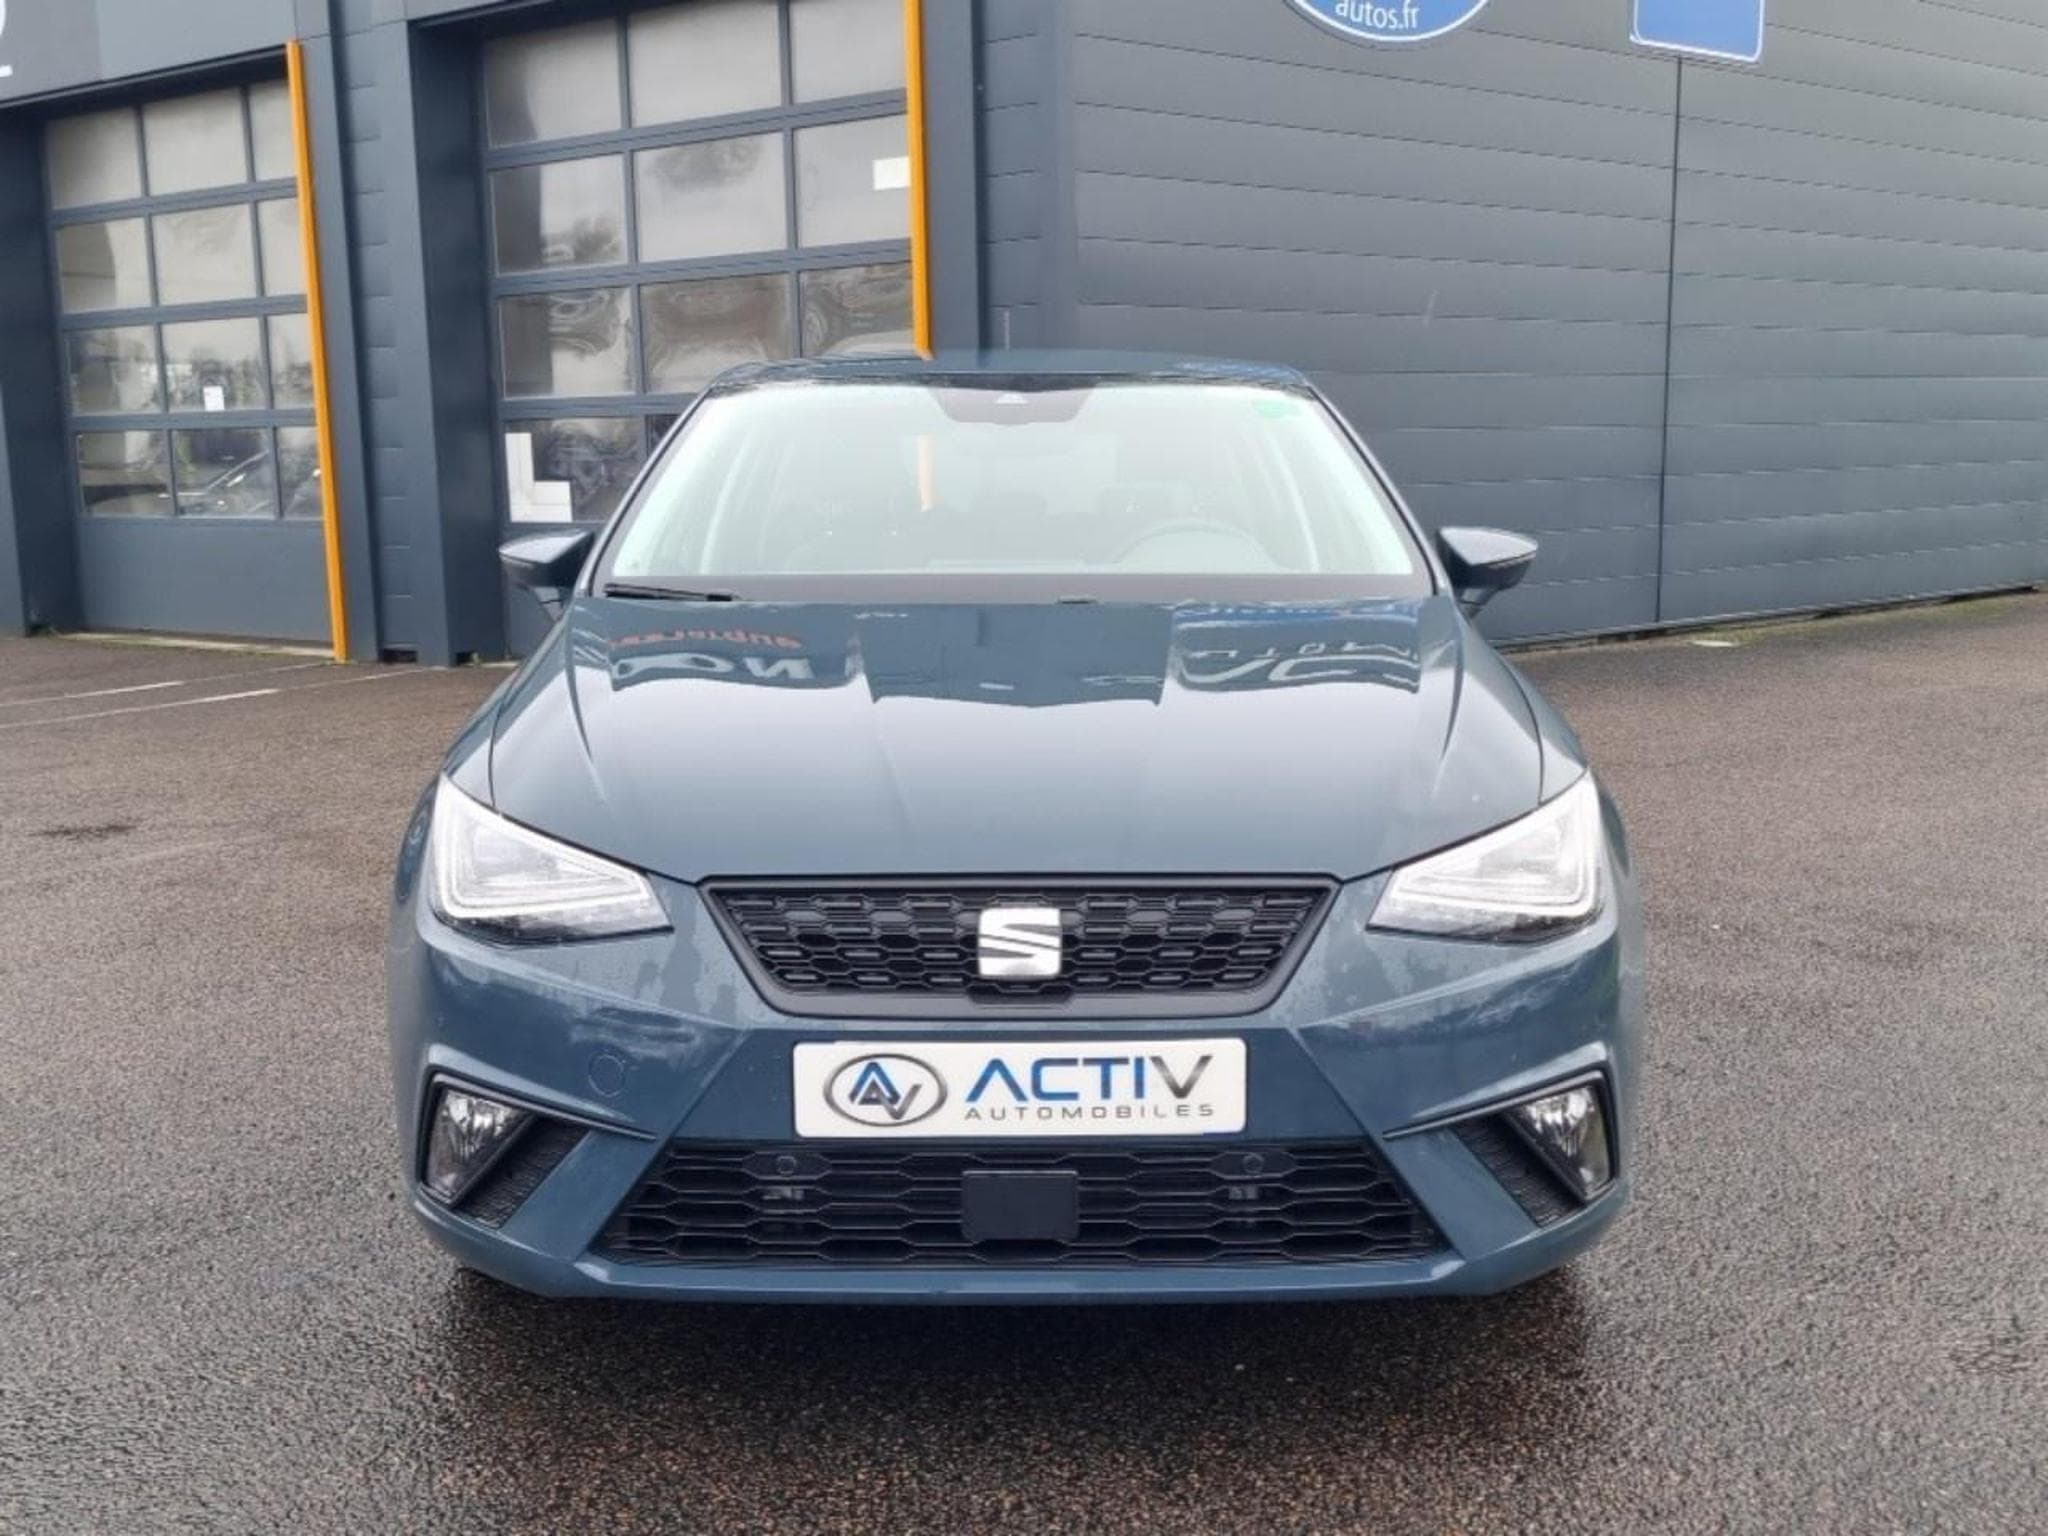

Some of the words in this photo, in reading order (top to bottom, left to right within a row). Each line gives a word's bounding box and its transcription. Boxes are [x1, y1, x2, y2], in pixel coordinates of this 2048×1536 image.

[1335, 0, 1420, 29] autos.fr
[965, 1055, 1213, 1102] ACTIV
[964, 1104, 1214, 1121] AUTOMOBILES
